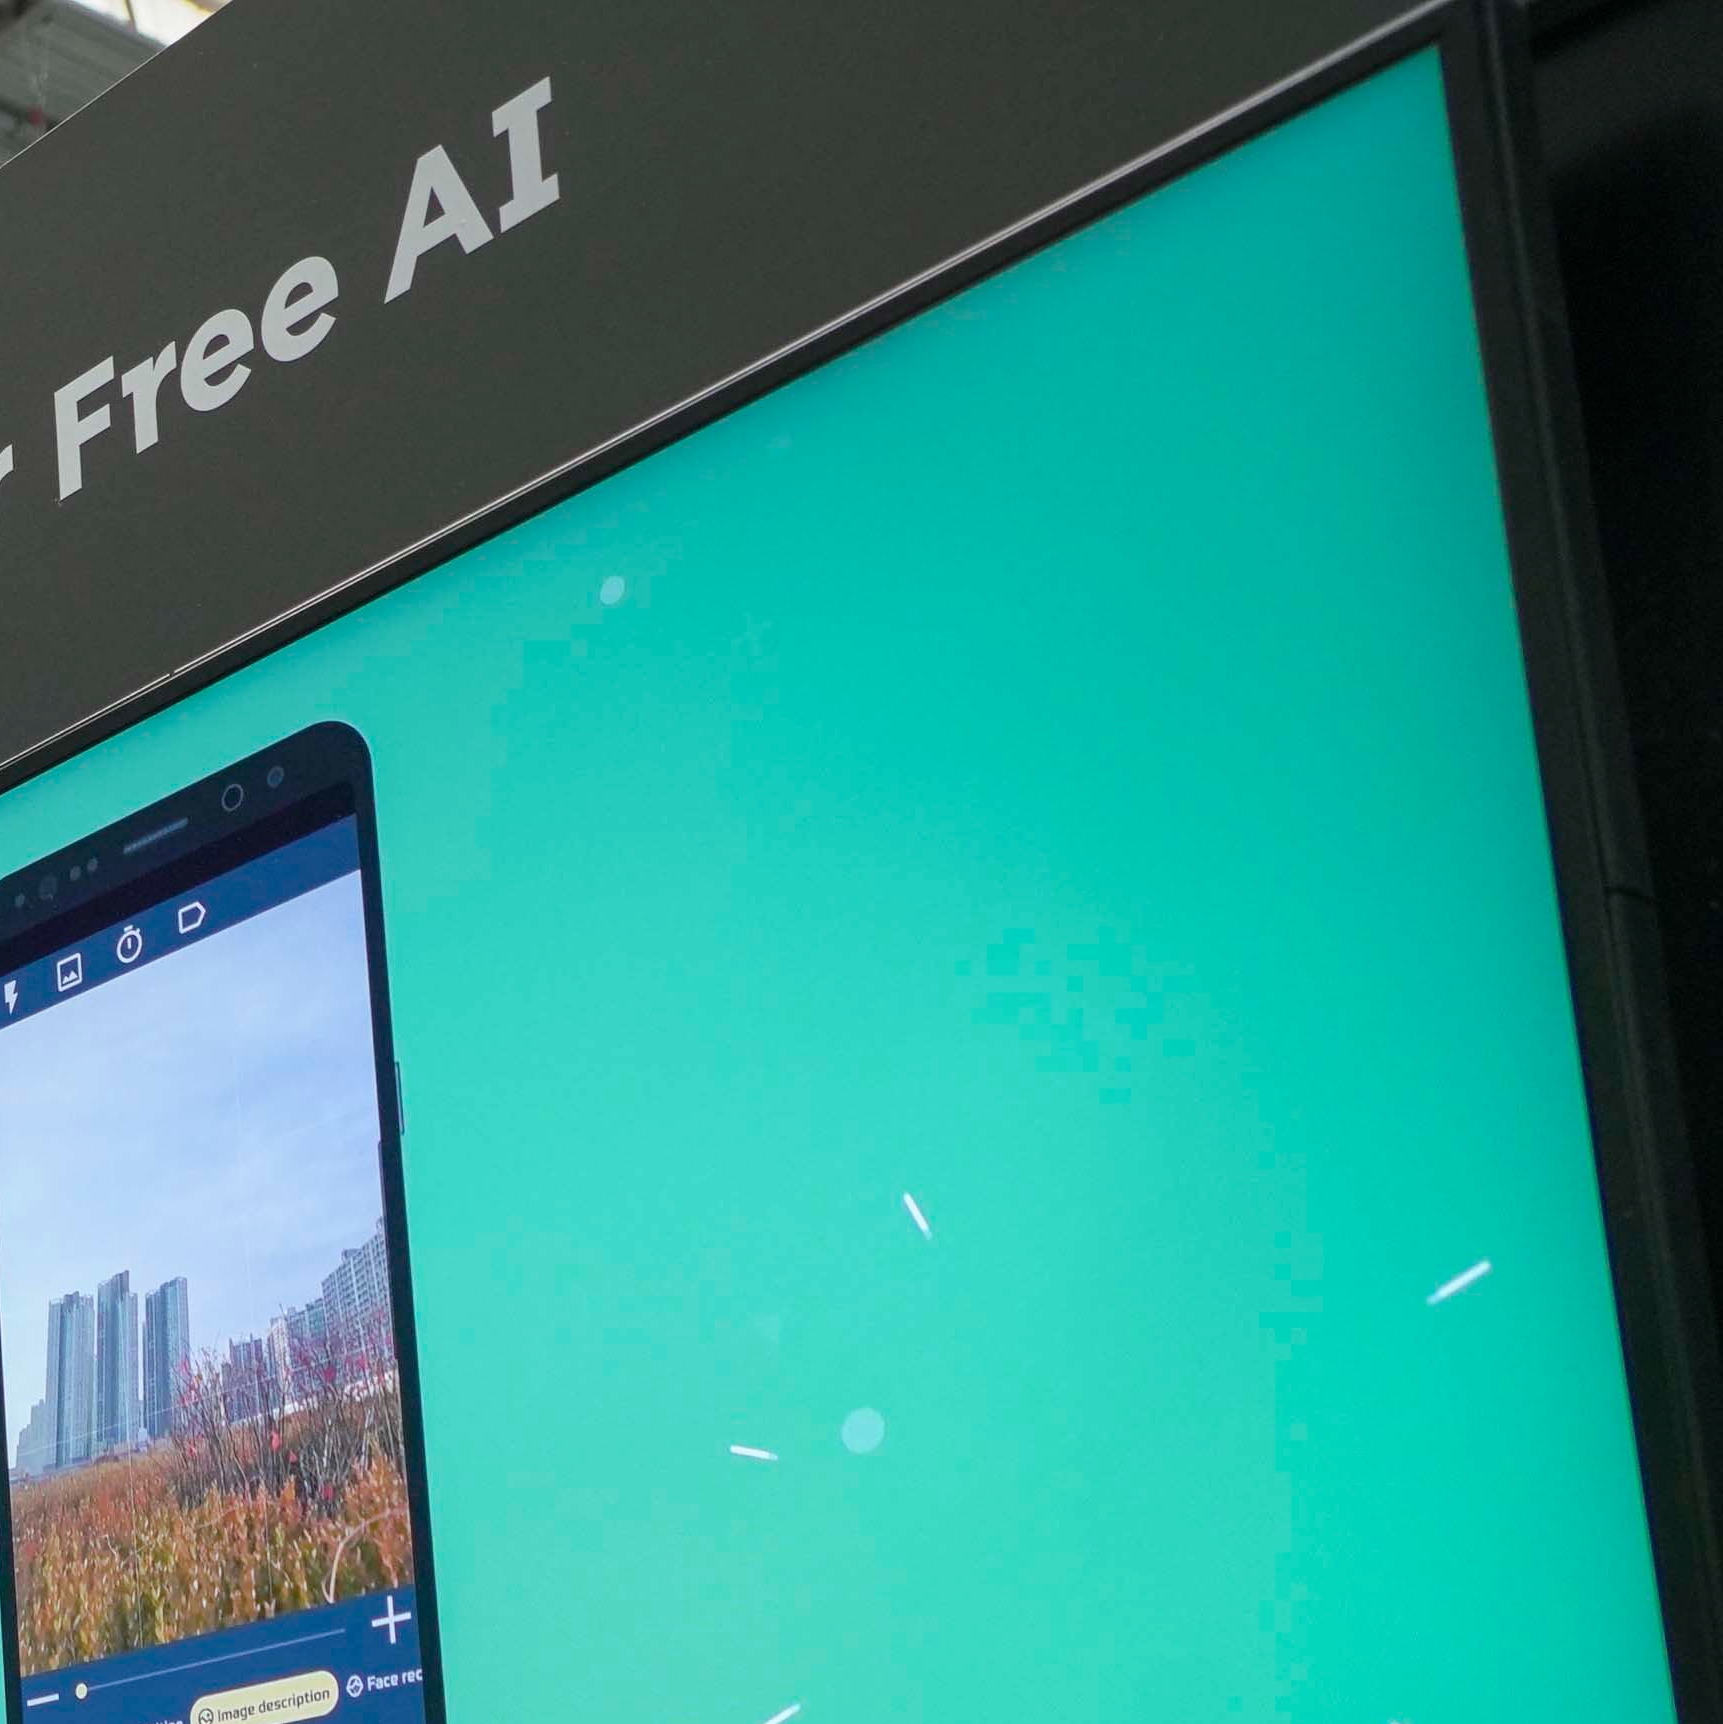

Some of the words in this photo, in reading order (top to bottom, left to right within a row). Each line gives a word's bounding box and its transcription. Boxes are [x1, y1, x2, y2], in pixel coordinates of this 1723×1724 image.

[52, 255, 339, 504] Free
[384, 77, 562, 304] AI
[367, 1673, 398, 1693] Face
[217, 1702, 255, 1724] Image
[258, 1687, 330, 1718] description
